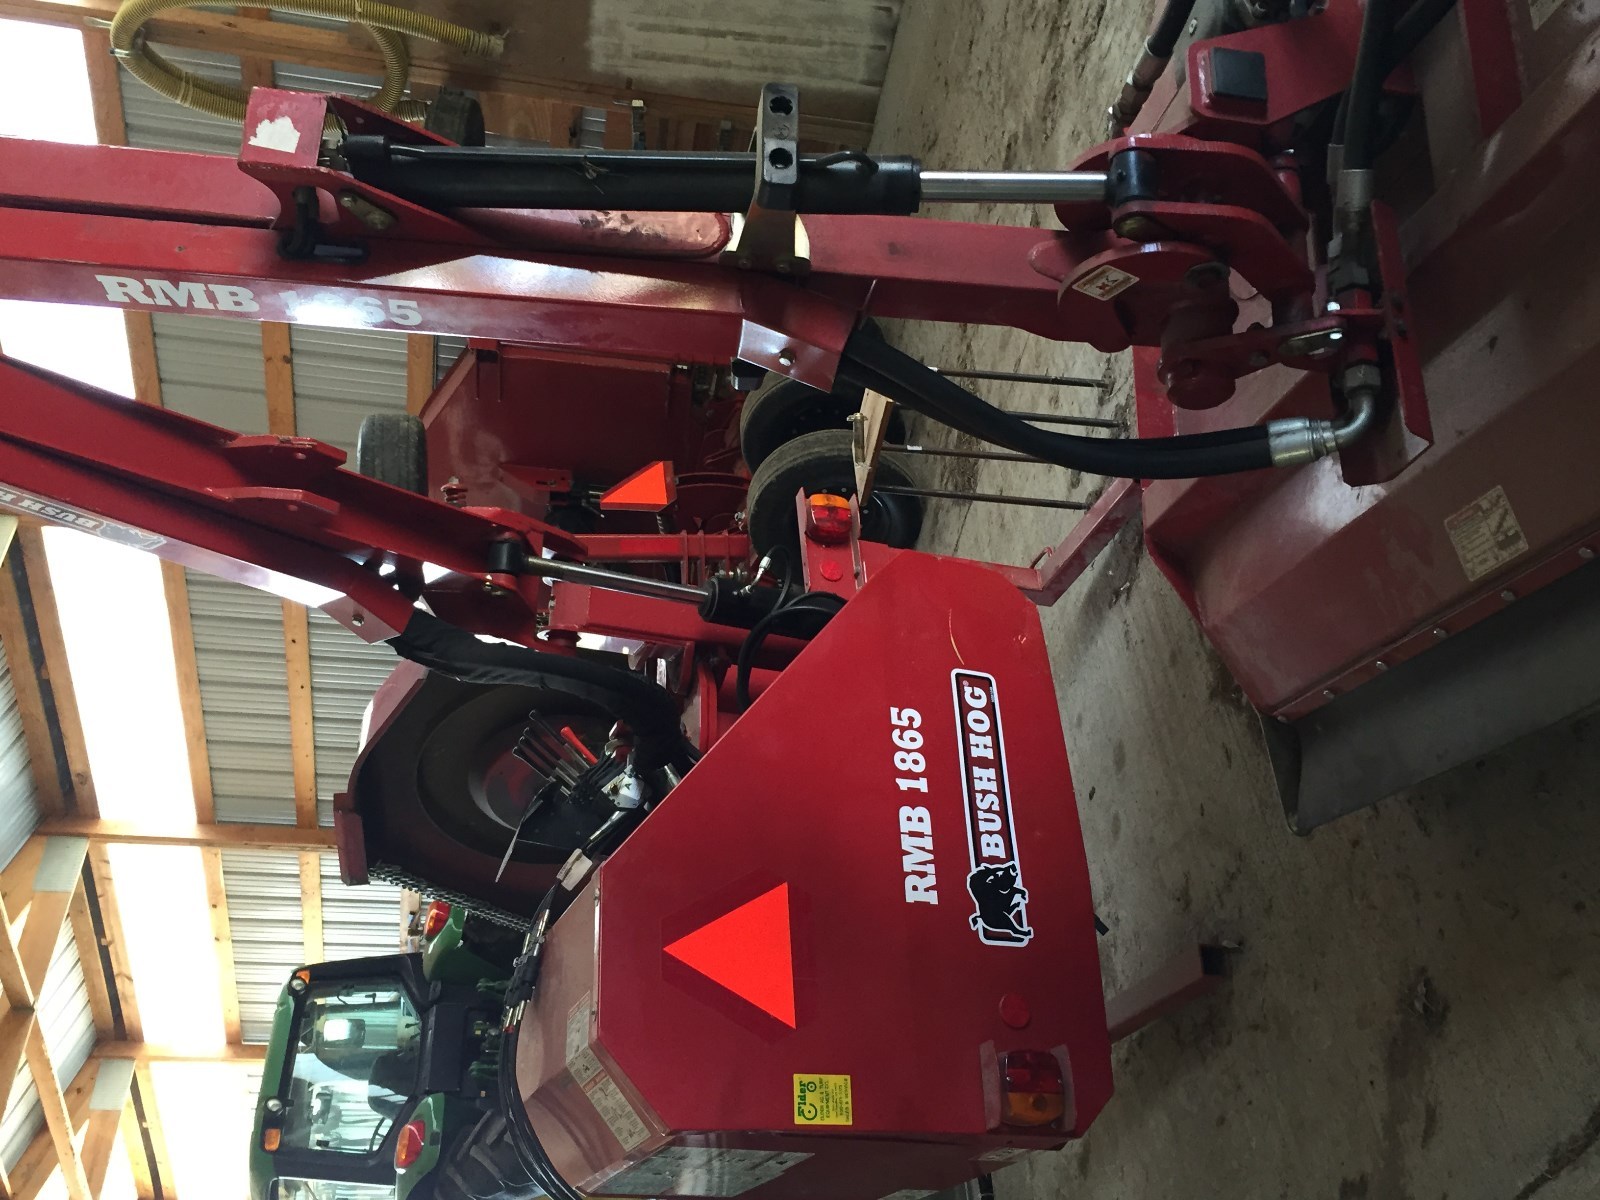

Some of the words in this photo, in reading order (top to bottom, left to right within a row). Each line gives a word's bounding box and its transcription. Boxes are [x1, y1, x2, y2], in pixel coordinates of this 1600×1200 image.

[95, 274, 260, 313] RMB
[18, 499, 99, 528] BUSH
[890, 706, 929, 793] 1865
[898, 805, 939, 905] RMB
[972, 766, 1006, 859] BUSH
